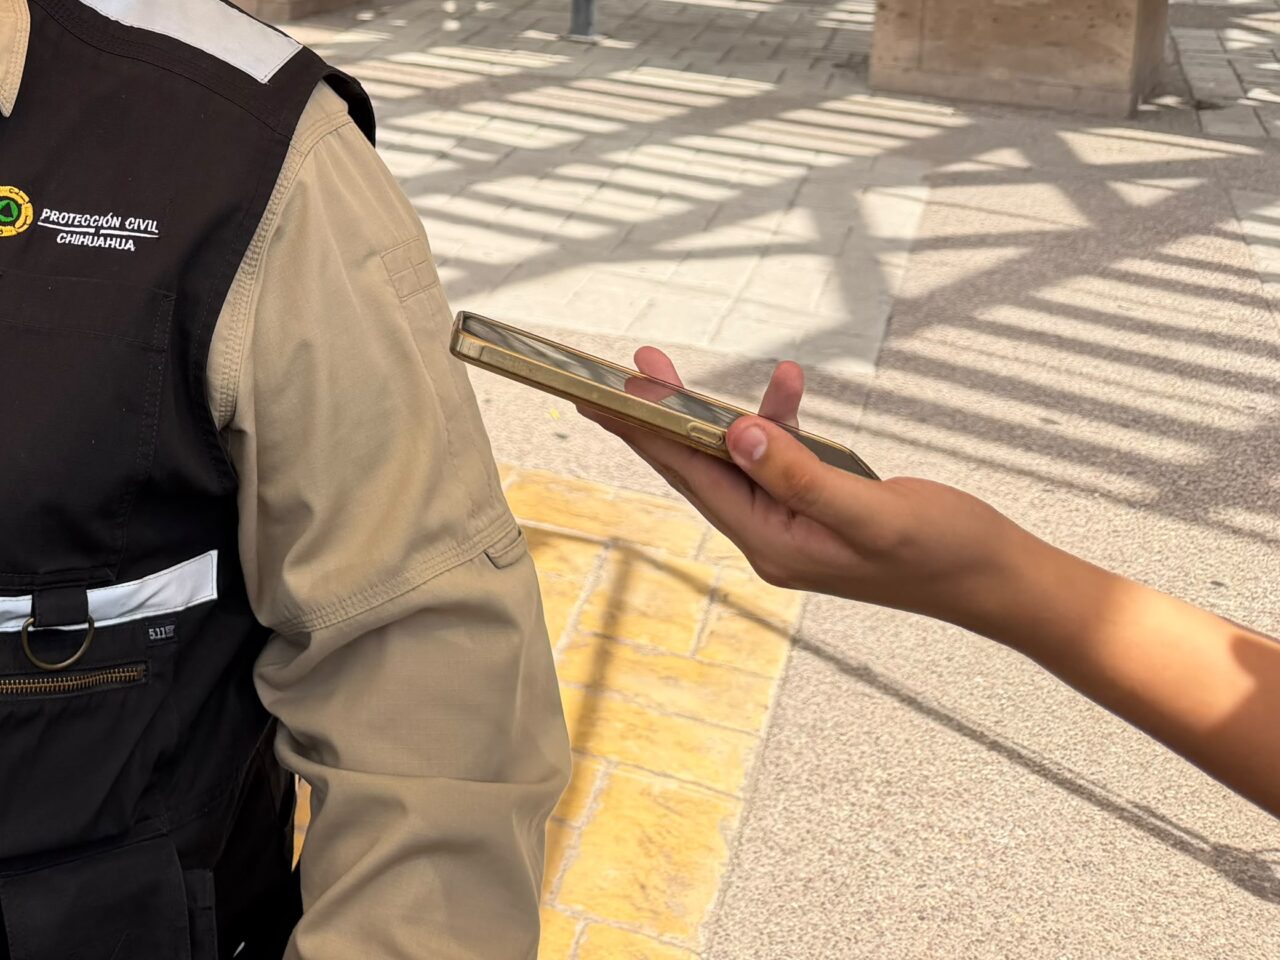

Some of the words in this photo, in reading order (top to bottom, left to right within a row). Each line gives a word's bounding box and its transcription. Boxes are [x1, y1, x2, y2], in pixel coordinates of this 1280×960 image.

[39, 208, 121, 228] PROTECCIÓN
[125, 217, 159, 233] CIVIL
[56, 233, 136, 251] CHIHUAHUA
